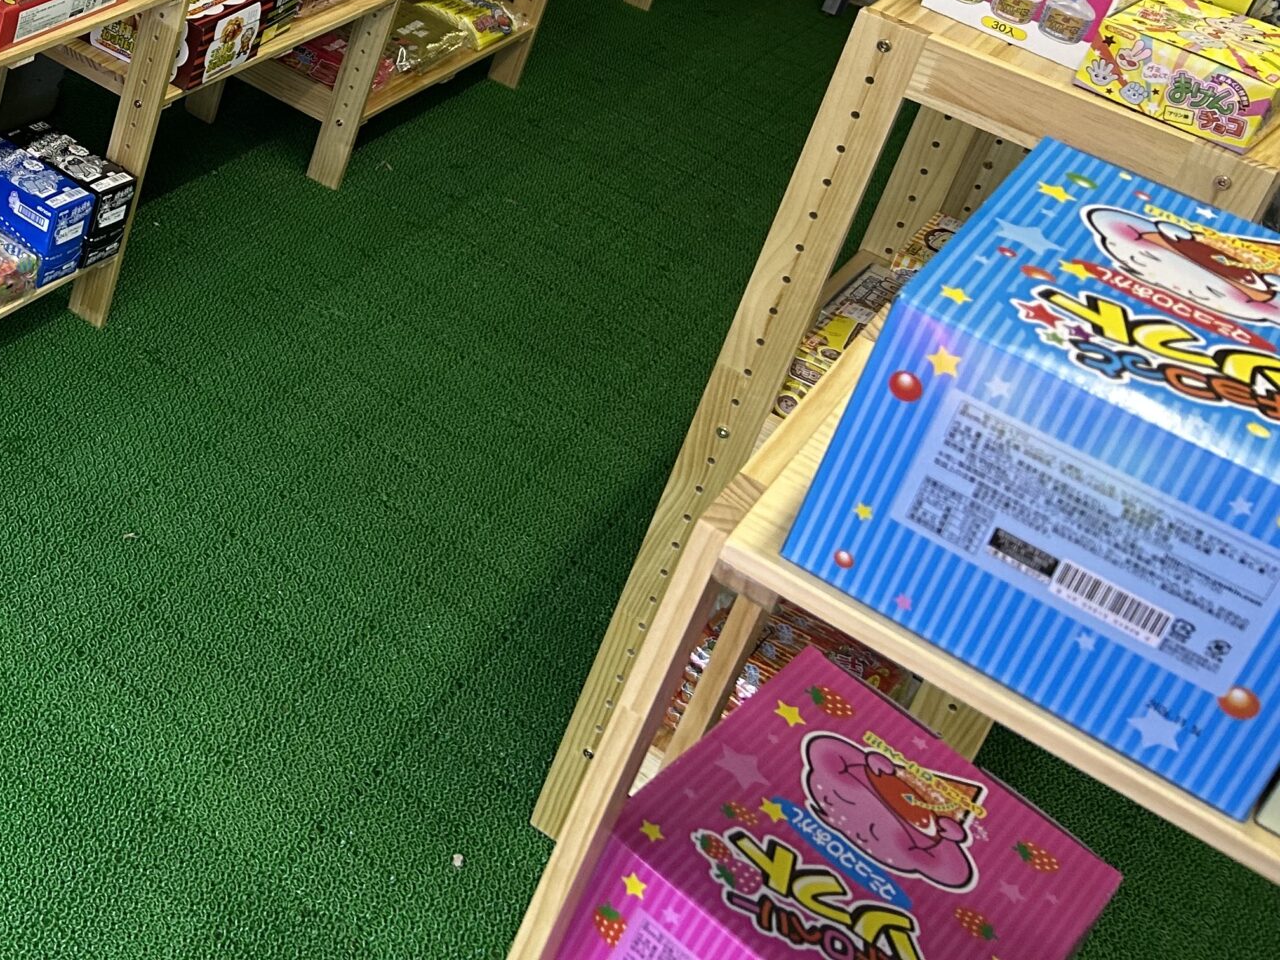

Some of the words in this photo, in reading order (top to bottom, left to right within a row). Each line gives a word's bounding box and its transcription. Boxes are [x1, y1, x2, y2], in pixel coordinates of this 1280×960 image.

[991, 19, 1016, 38] 30入
[1167, 72, 1236, 116] まけん
[1198, 109, 1248, 139] チョコ
